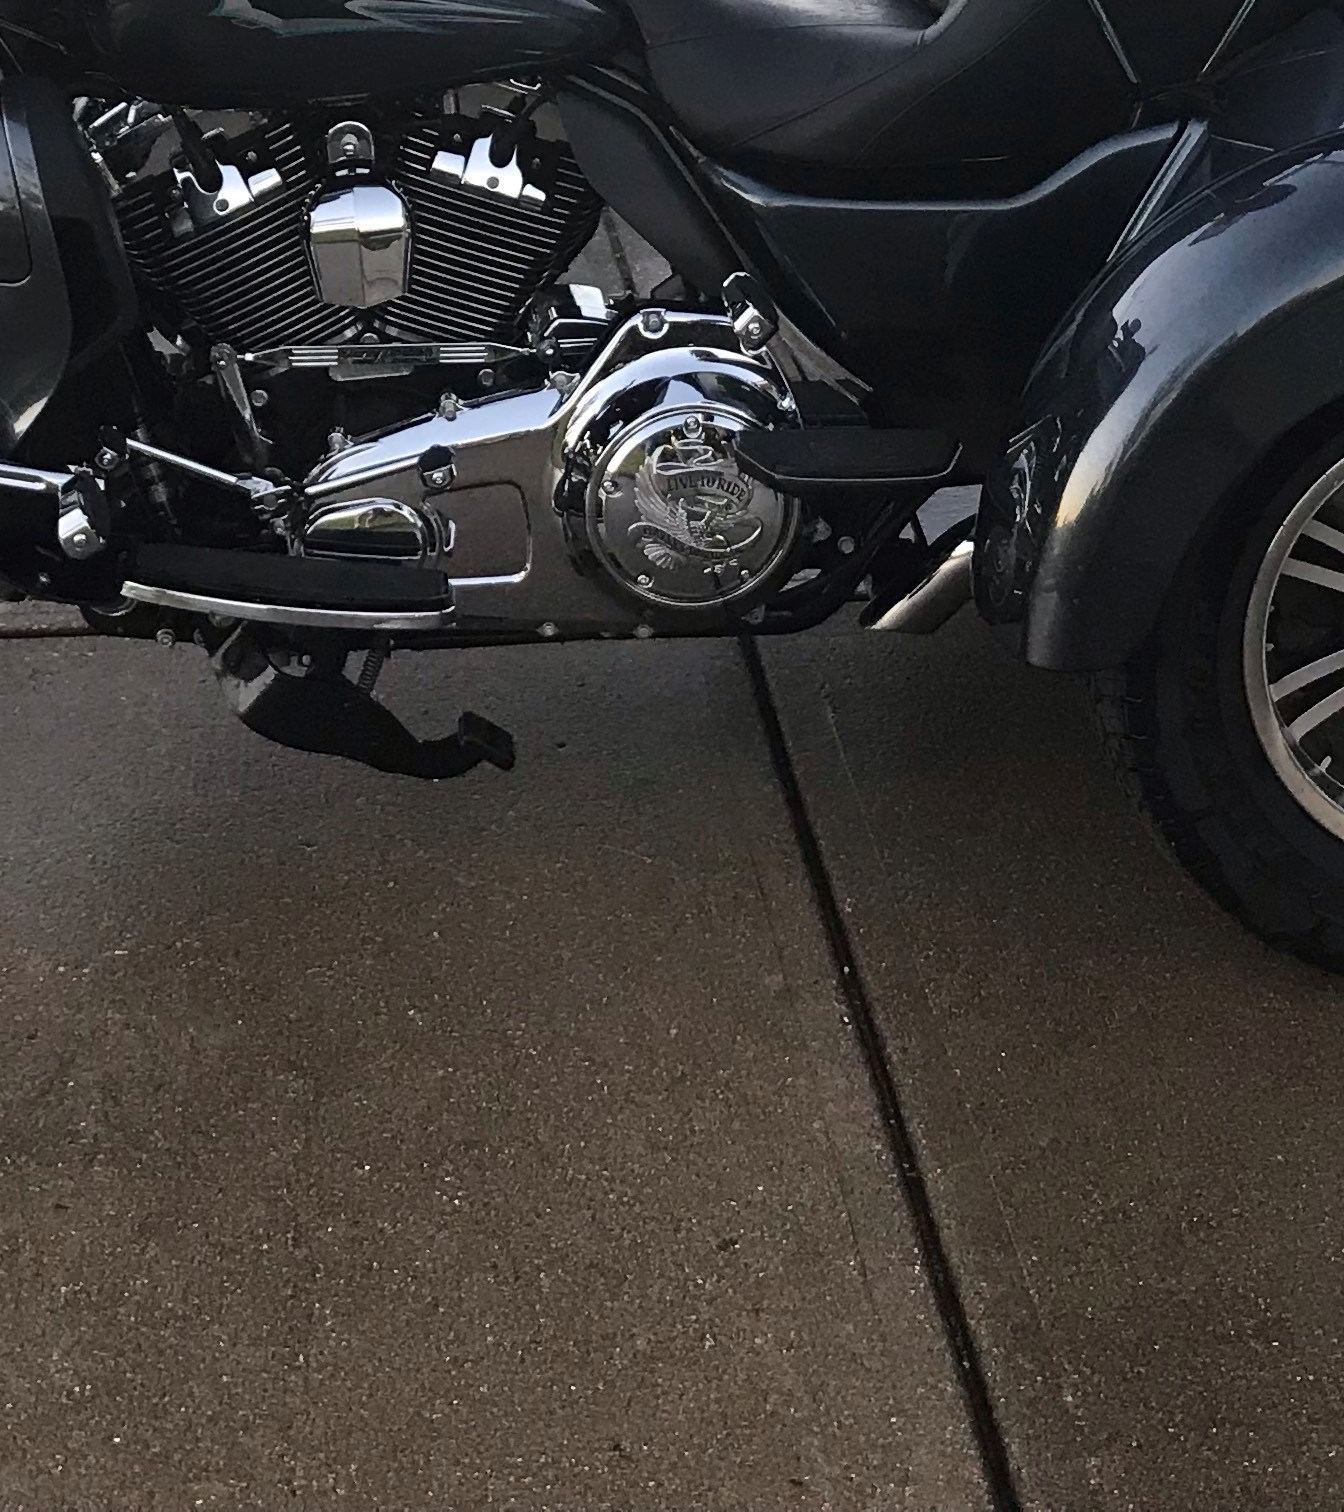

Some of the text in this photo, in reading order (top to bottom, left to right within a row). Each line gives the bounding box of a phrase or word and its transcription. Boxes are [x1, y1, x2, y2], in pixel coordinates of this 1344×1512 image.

[666, 474, 747, 502] LIVE TO RIDE
